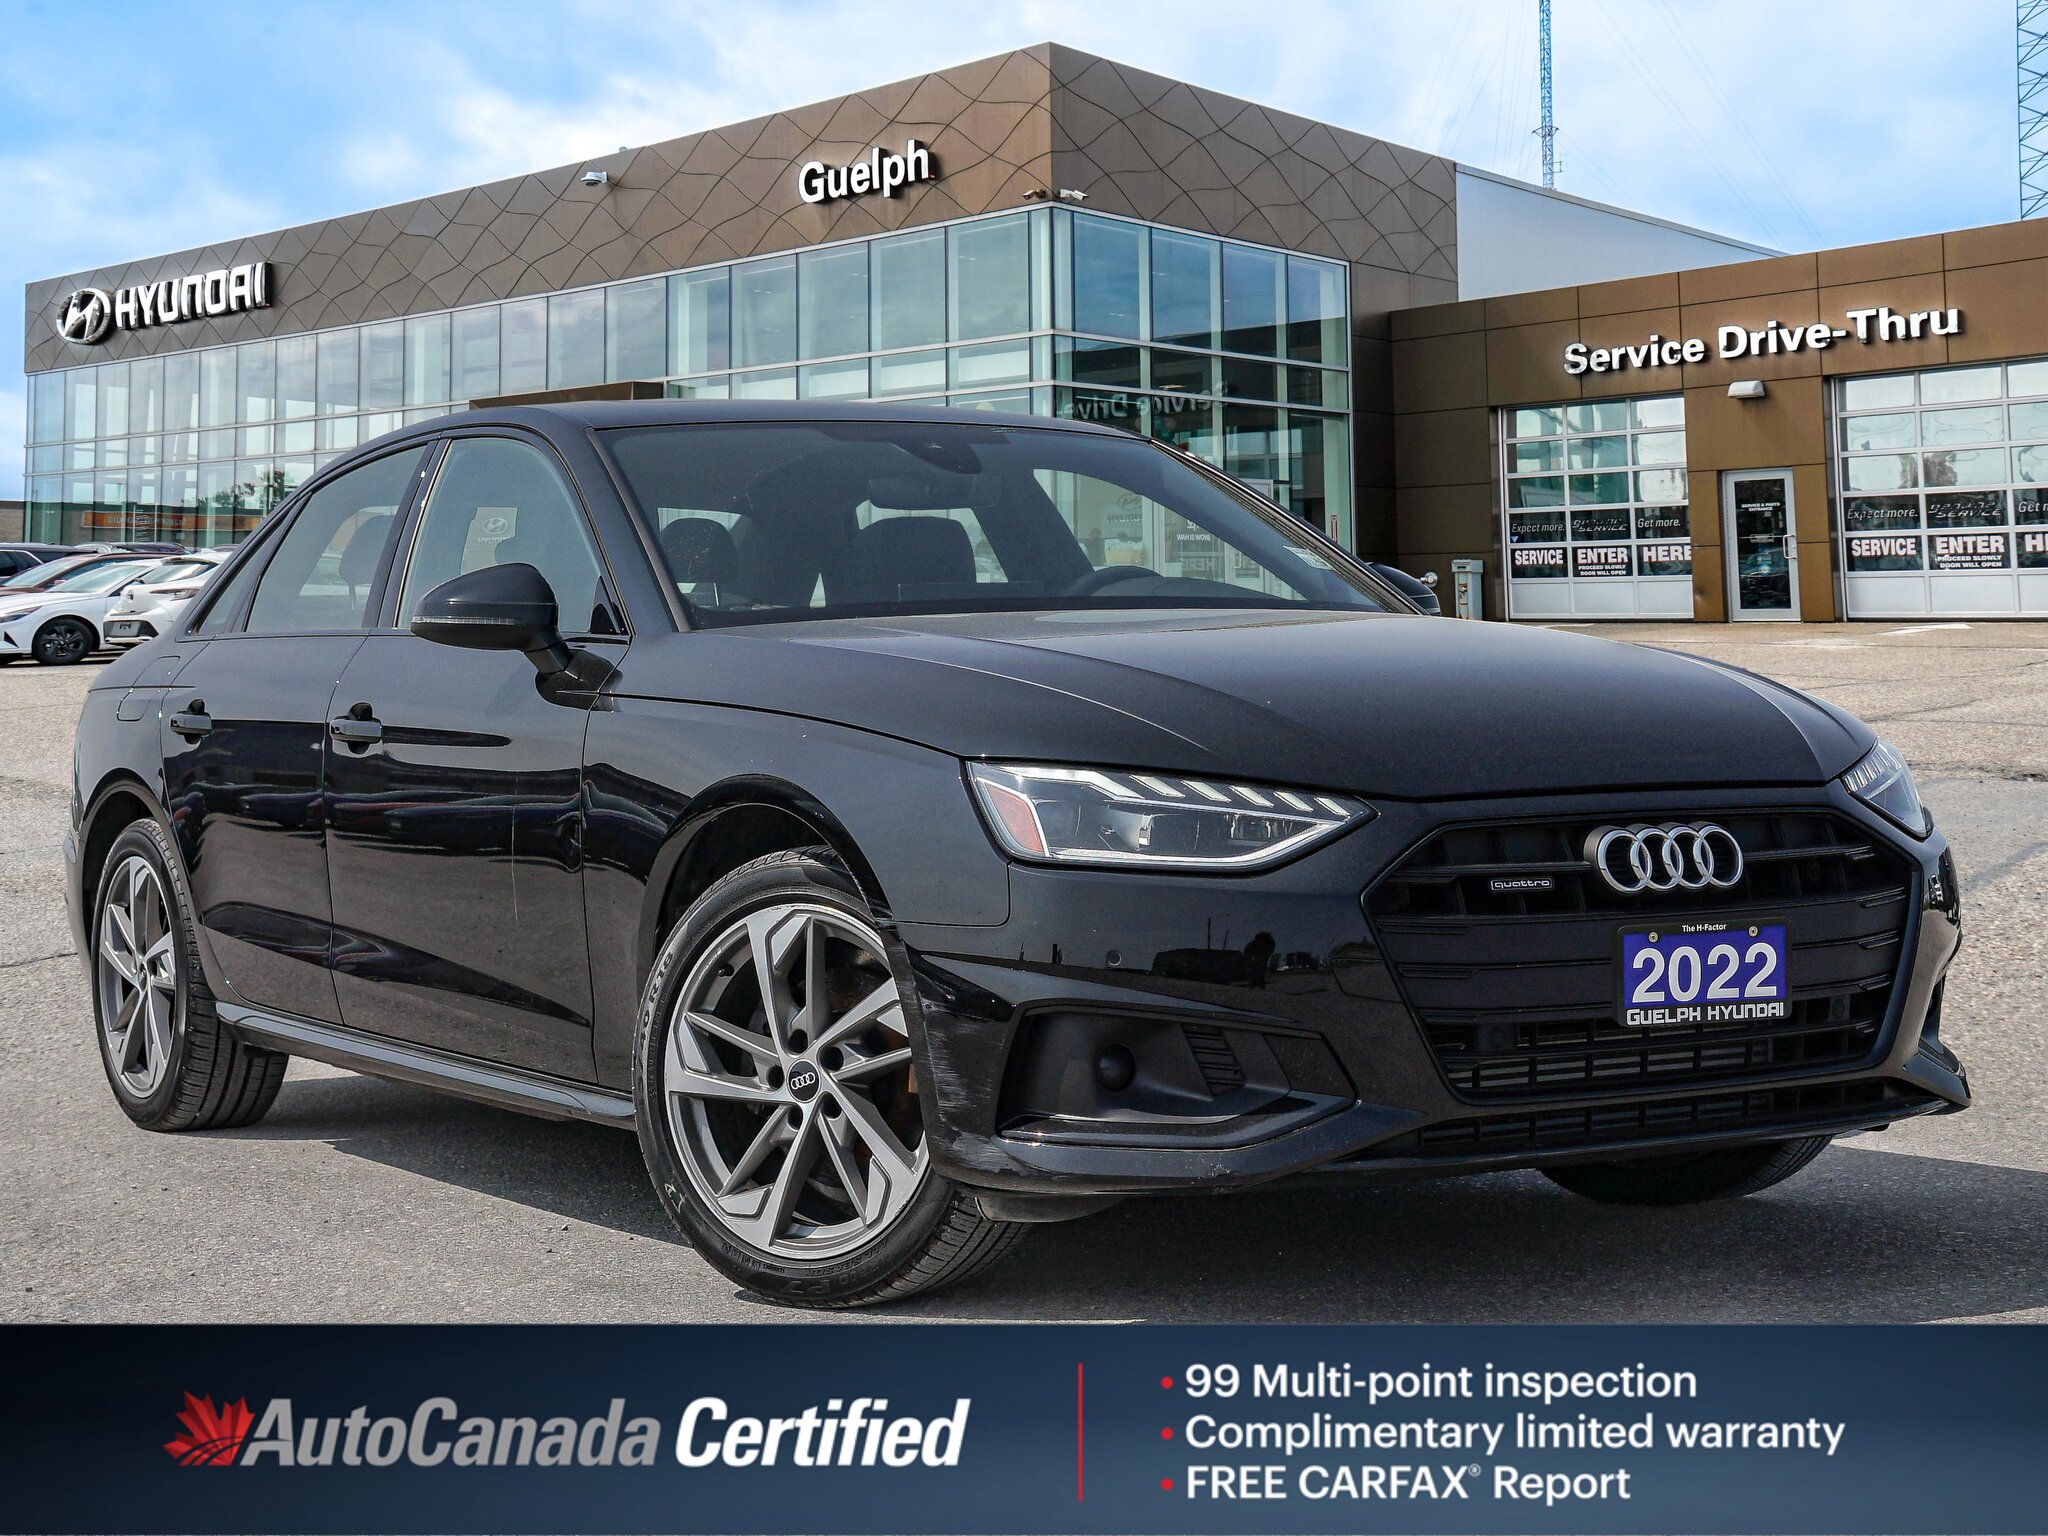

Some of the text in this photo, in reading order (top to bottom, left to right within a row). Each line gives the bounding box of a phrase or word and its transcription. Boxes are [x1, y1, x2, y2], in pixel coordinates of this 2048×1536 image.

[798, 139, 930, 203] Guelph
[115, 262, 267, 330] HYUNDAI
[1564, 307, 1960, 374] Service Drive-Thru
[1848, 508, 1918, 520] Expect more.
[1936, 508, 2002, 518] SERVICE
[2018, 502, 2040, 513] Get
[1512, 523, 1565, 534] Expect more.
[1638, 518, 1681, 528] Get more.
[1852, 538, 1916, 557] SERVICE
[1936, 535, 2005, 555] ENTER
[1515, 549, 1564, 565] SERVICE
[1577, 547, 1629, 564] ENTER
[1494, 879, 1550, 890] quattro
[1696, 923, 1727, 932] H-Factor
[1632, 942, 1777, 1003] 2022
[1627, 1002, 1784, 1025] GUELPH HYUNDAI
